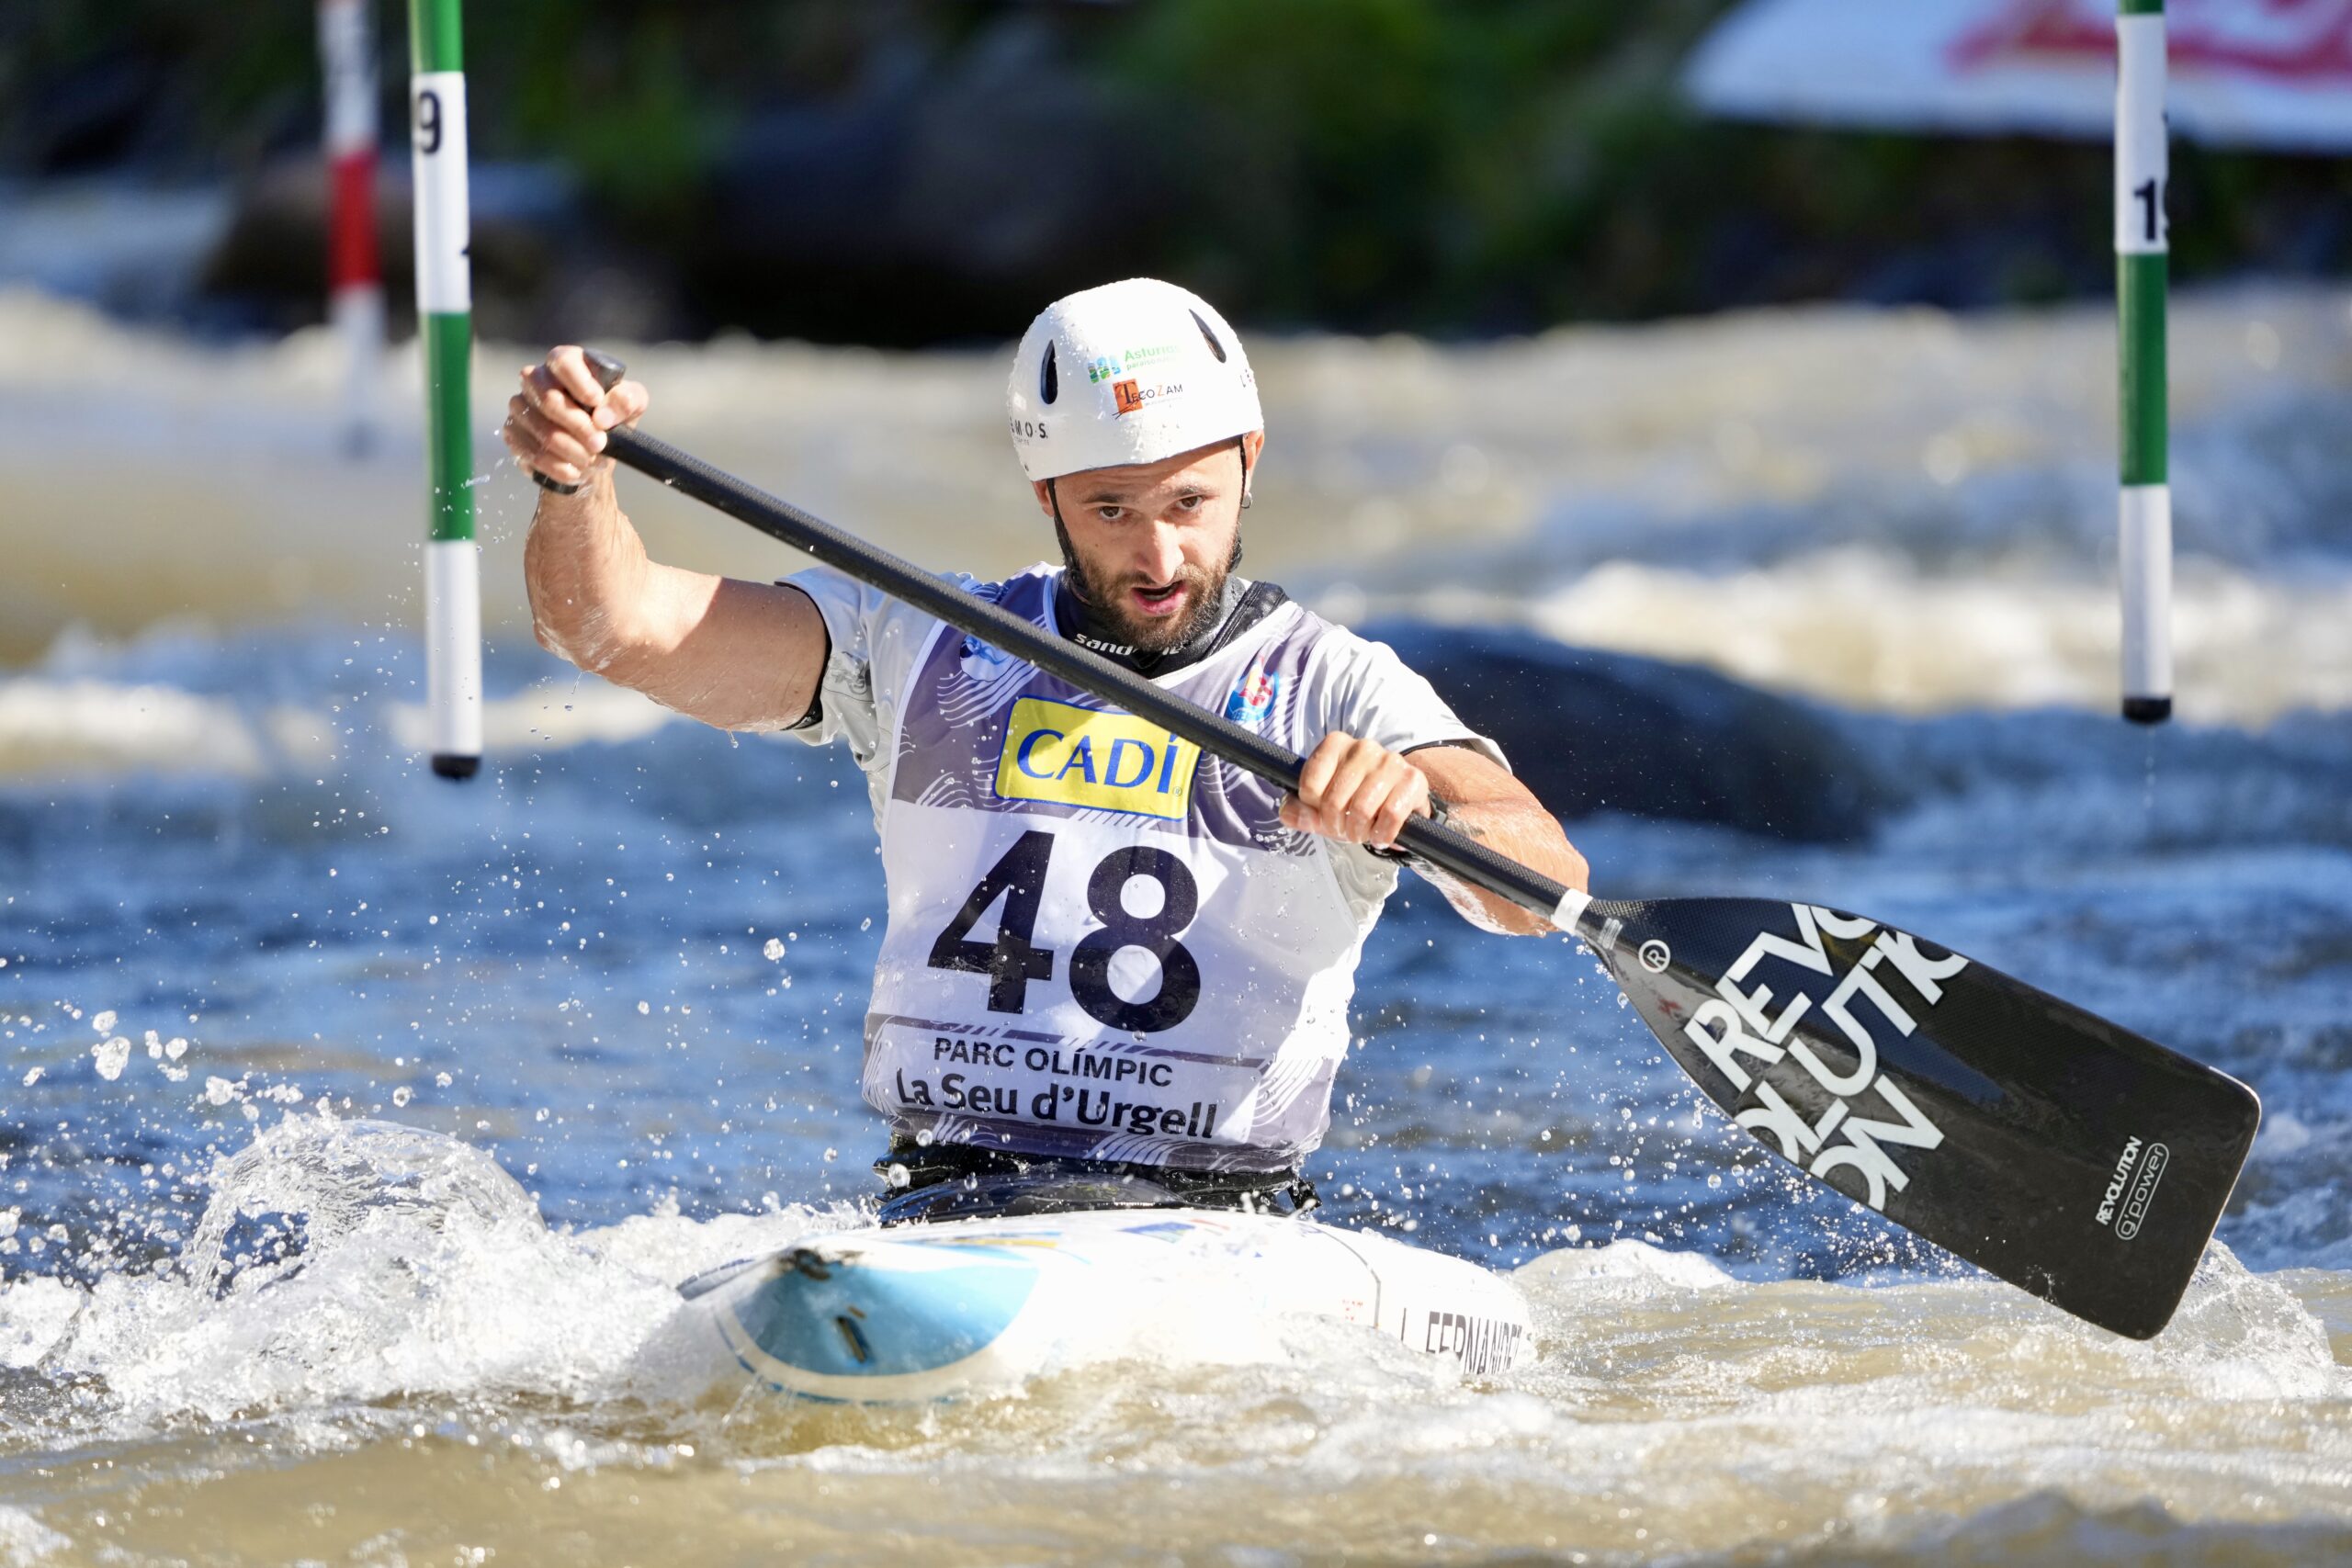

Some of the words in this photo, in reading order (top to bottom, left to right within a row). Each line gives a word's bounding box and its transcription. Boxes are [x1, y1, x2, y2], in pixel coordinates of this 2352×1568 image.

[418, 89, 442, 155] 9
[2133, 177, 2167, 243] 1
[927, 829, 1201, 1032] 48
[1684, 903, 1879, 1093] REV
[933, 1036, 1015, 1069] PARC
[1023, 1046, 1174, 1088] OLÍMPIC
[940, 1073, 1019, 1115] Seu
[1031, 1084, 1217, 1139] d'Urgell
[2095, 1135, 2143, 1226] REVOLUTION
